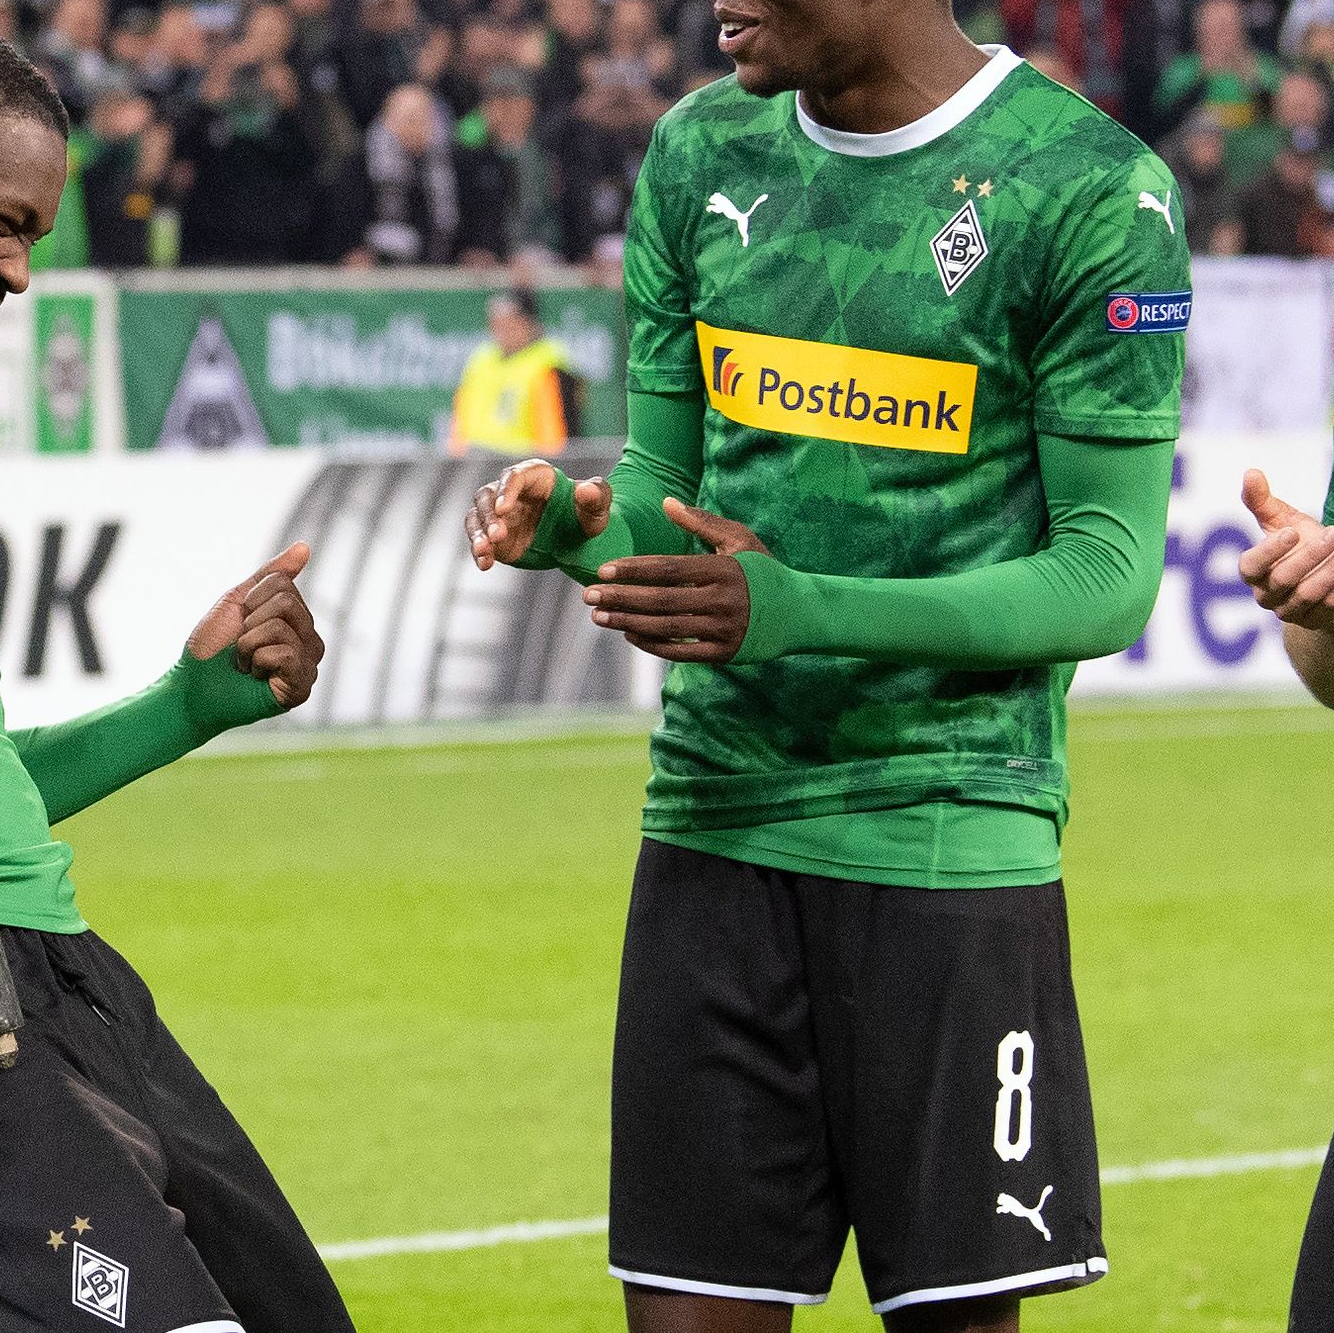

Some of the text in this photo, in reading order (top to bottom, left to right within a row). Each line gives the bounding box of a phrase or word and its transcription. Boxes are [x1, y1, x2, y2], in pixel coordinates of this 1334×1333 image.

[946, 229, 974, 265] B
[1140, 301, 1192, 322] RESPECT
[757, 367, 962, 432] Postbank
[993, 1030, 1035, 1162] 8
